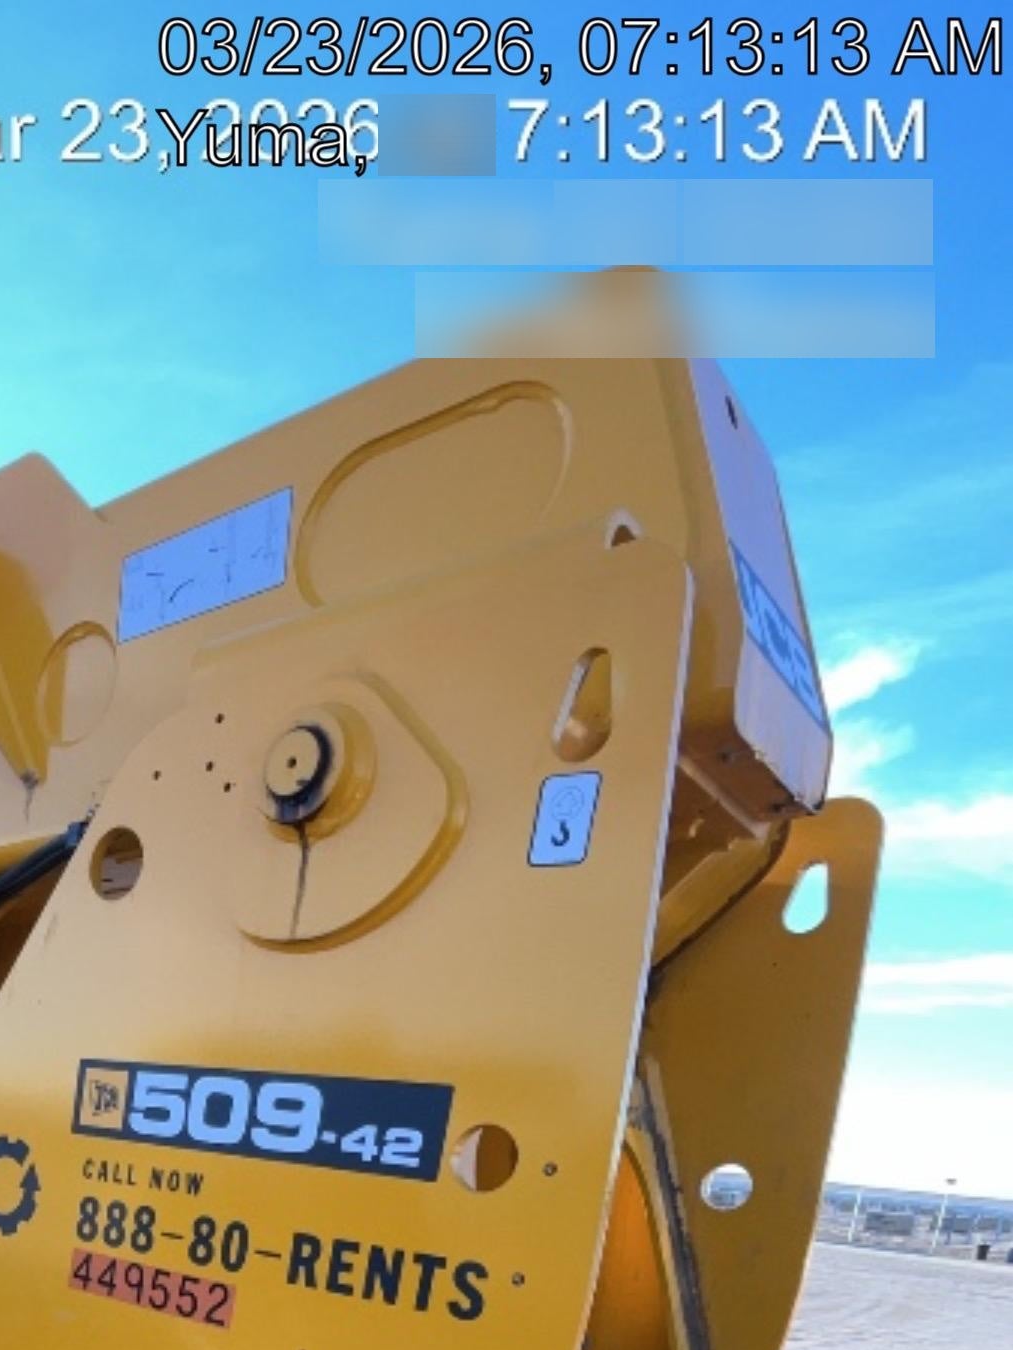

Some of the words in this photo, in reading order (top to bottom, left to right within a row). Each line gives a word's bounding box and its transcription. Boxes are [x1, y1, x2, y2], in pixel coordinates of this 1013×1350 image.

[128, 1070, 424, 1168] 509-42
[83, 1159, 137, 1186] CALL
[149, 1167, 204, 1196] NOW
[73, 1252, 230, 1327] 449552
[77, 1196, 489, 1321] 888-80-RENTS
